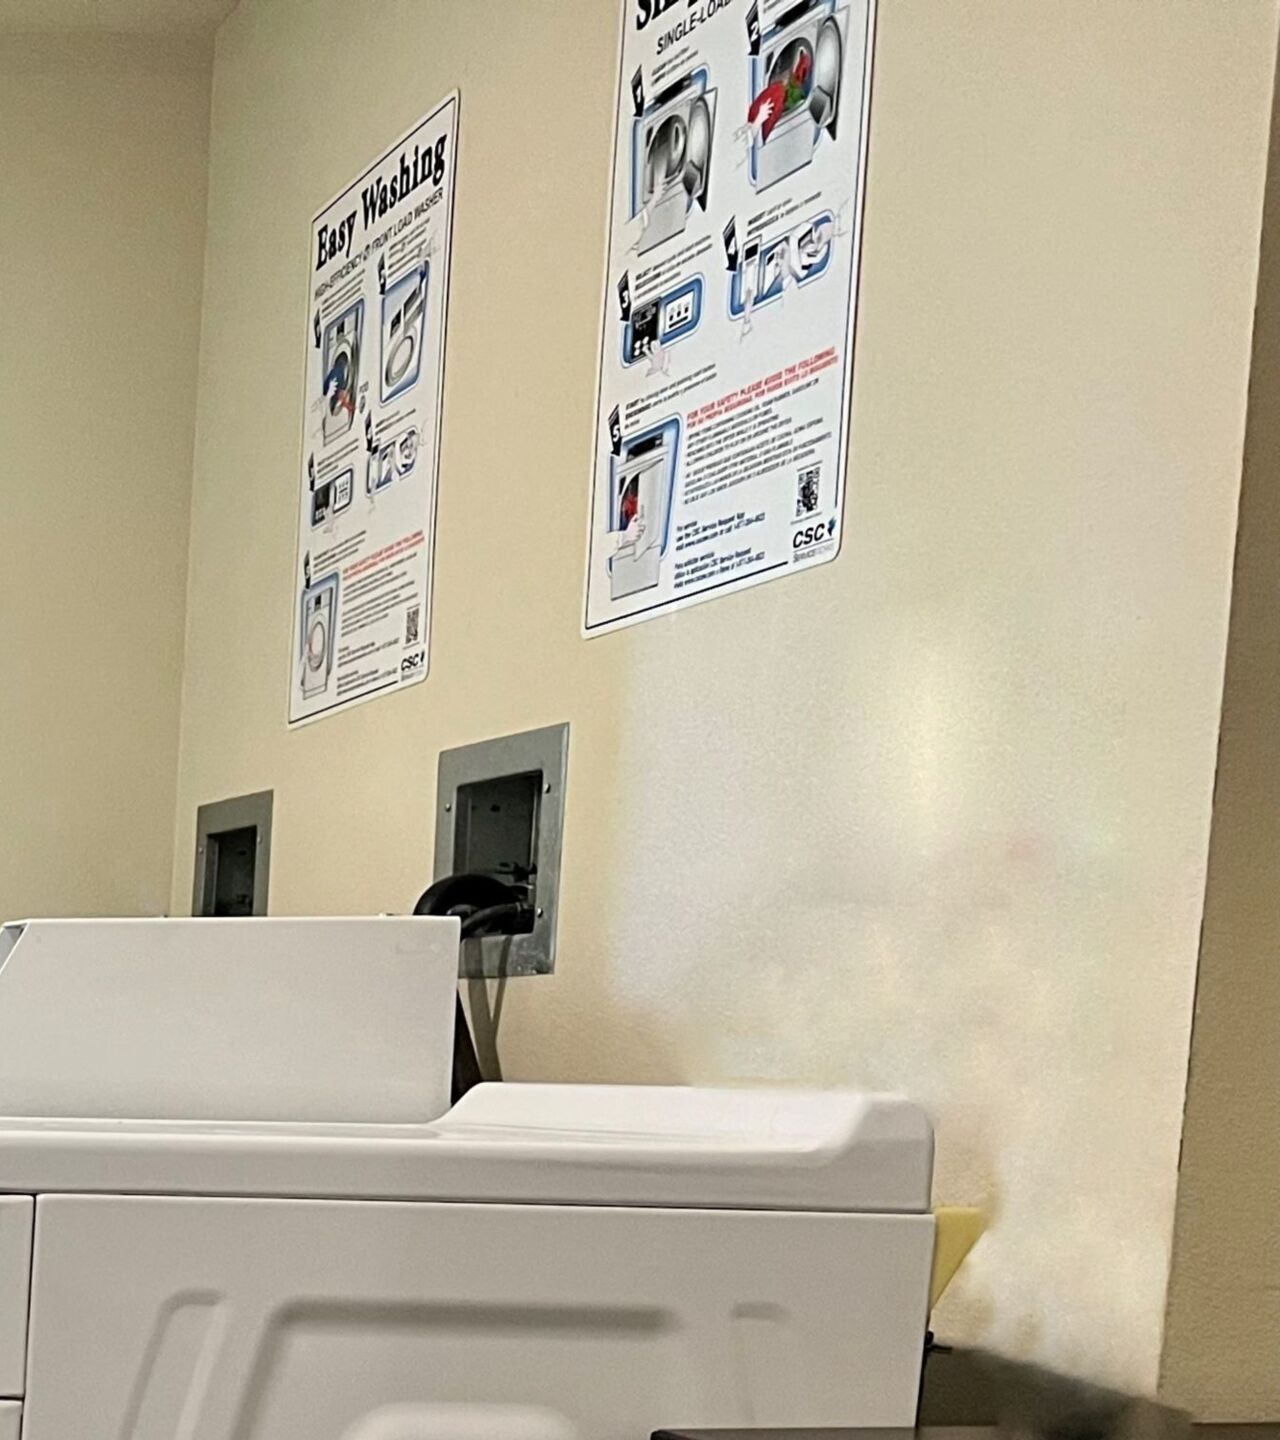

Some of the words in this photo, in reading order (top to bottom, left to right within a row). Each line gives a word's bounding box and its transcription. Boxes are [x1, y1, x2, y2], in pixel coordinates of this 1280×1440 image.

[315, 209, 358, 271] Easy
[361, 134, 448, 232] Washing
[393, 211, 414, 237] LOAD
[414, 187, 444, 220] WASHER
[793, 523, 825, 549] CSC
